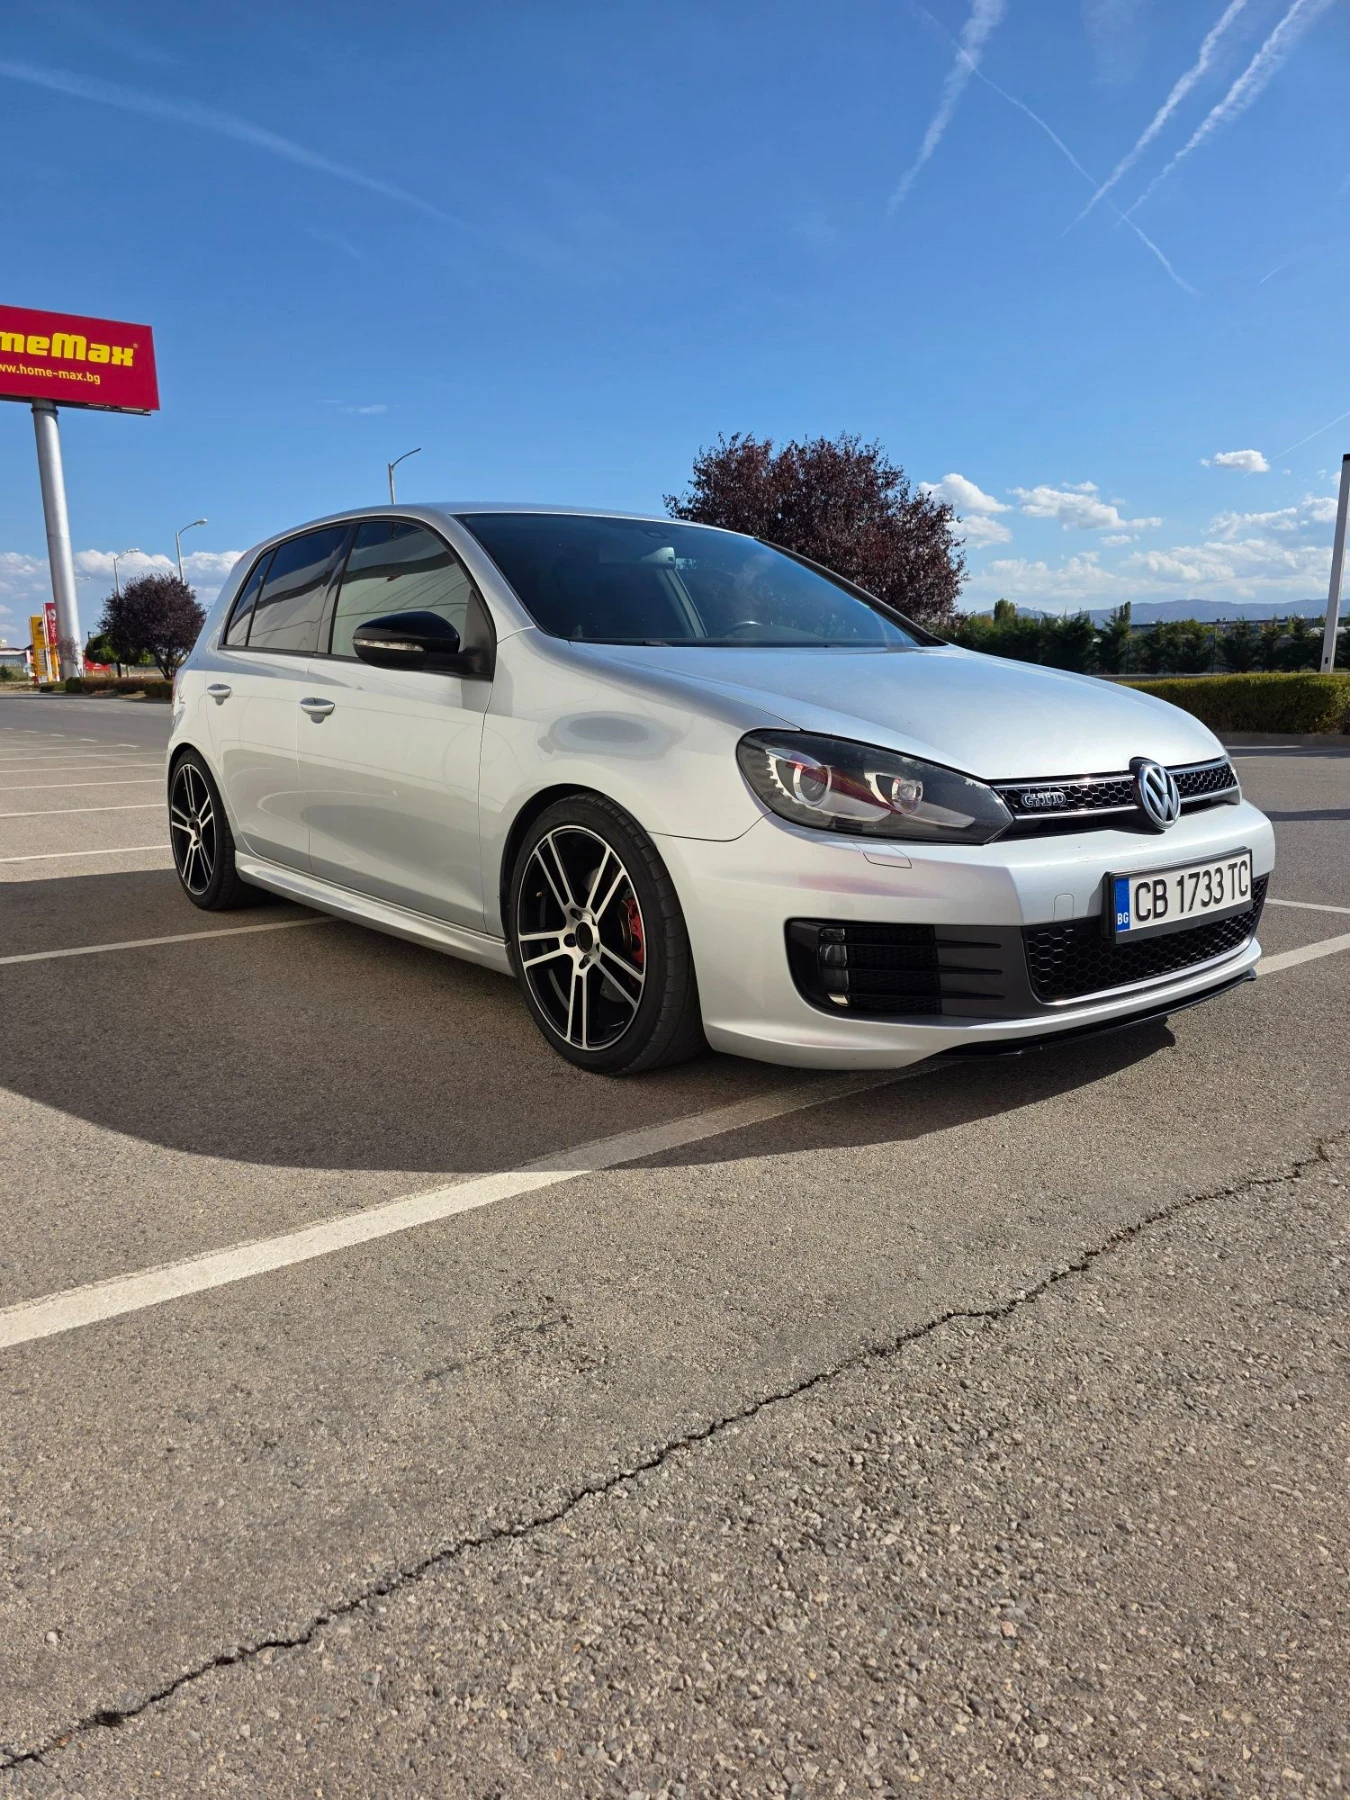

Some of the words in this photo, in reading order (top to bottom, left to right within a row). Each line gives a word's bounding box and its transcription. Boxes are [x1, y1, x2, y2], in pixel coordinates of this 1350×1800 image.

[1135, 879, 1168, 922] CB
[1176, 867, 1225, 914] 1733
[1228, 860, 1249, 900] TC
[1117, 912, 1129, 925] BG
